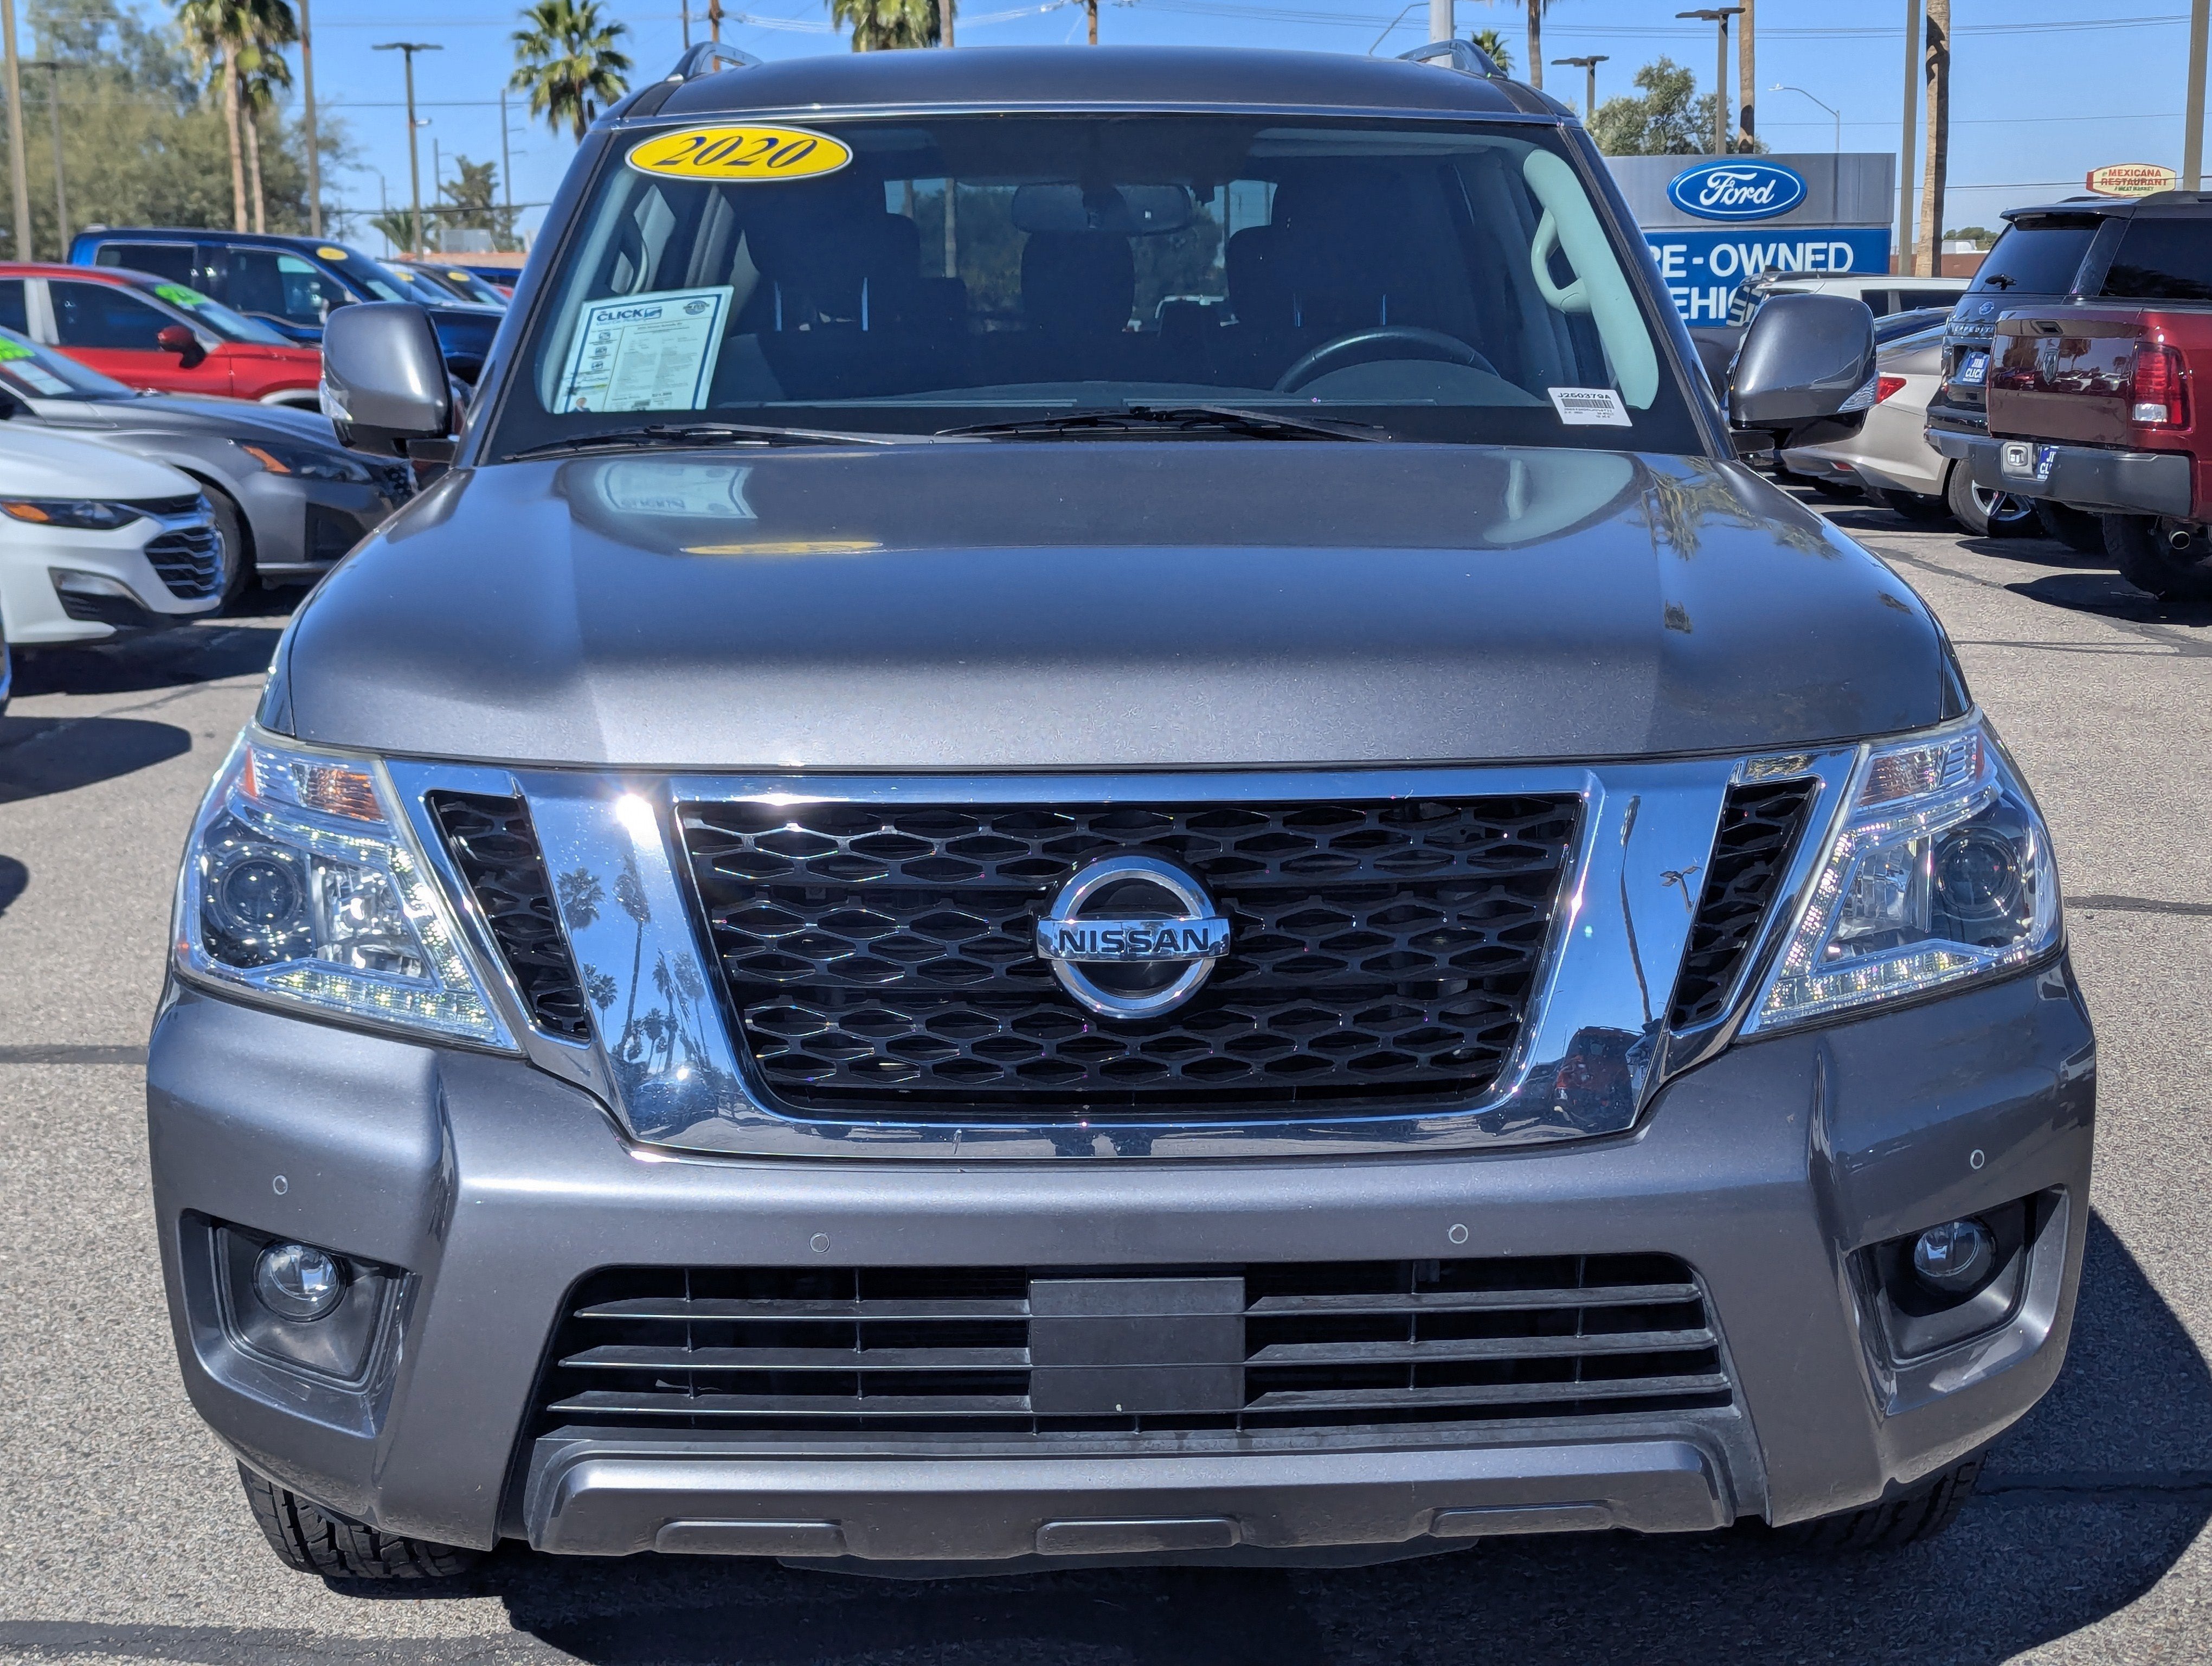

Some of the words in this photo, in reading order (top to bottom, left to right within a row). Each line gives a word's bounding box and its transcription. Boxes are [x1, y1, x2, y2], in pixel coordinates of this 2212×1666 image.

[652, 135, 818, 169] 2020
[2108, 169, 2162, 177] MEXICANA
[2100, 177, 2167, 186] RESTAURANT
[1699, 171, 1777, 206] Ford
[596, 309, 644, 322] CLICK
[1965, 368, 1985, 379] CLICK
[1058, 928, 1209, 953] NISSAN
